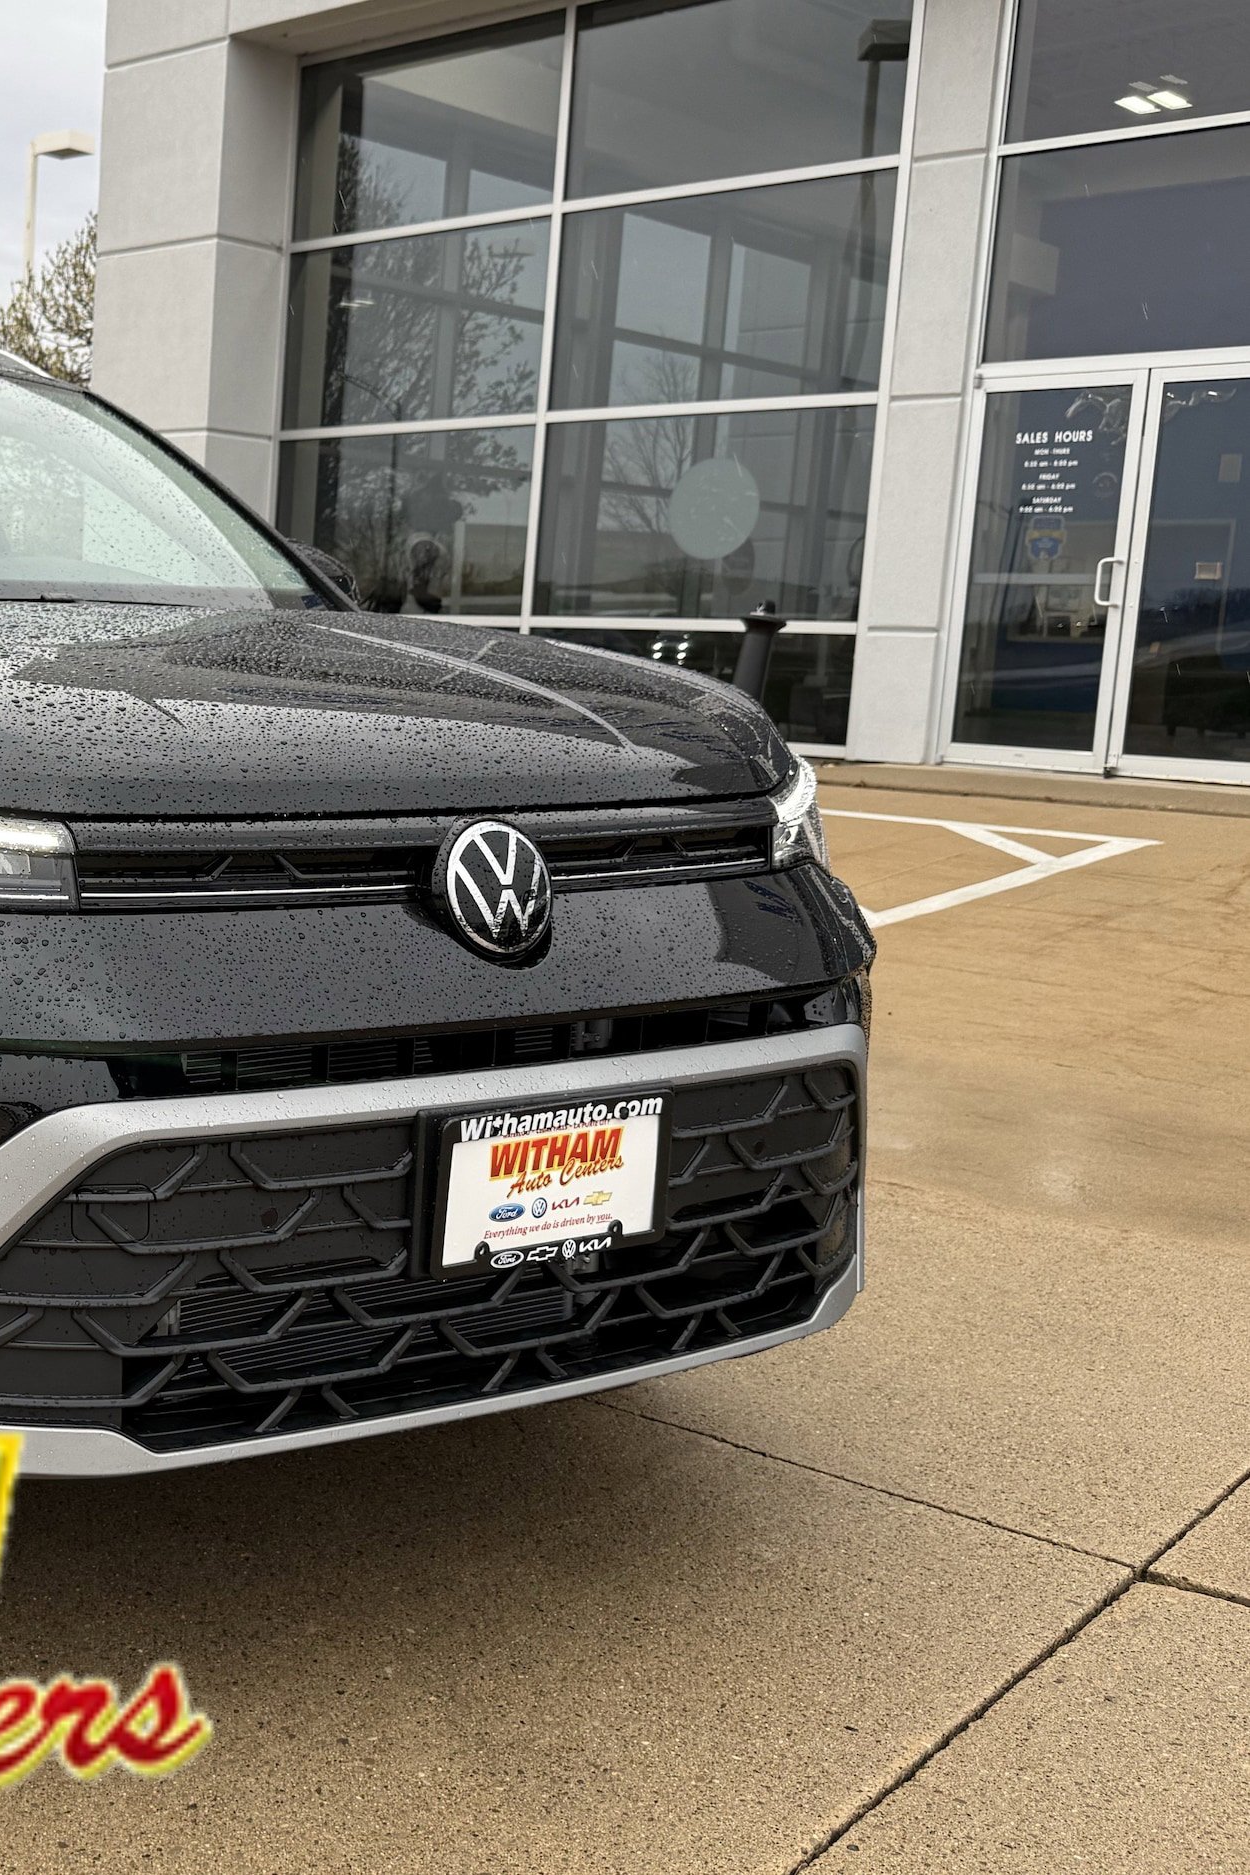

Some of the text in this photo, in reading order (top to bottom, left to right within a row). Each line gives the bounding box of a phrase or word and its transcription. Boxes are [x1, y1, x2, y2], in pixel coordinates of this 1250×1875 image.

[1015, 430, 1093, 444] SALES HOURS
[460, 1096, 663, 1142] Withamauto.com
[489, 1127, 625, 1180] WITHAM
[507, 1154, 625, 1198] Auto Centers
[495, 1206, 518, 1220] Ford
[484, 1225, 528, 1240] Everything
[529, 1224, 540, 1233] we
[541, 1221, 551, 1230] do
[553, 1219, 559, 1229] is
[560, 1215, 585, 1227] driven
[586, 1214, 596, 1225] by
[497, 1253, 517, 1265] Ford
